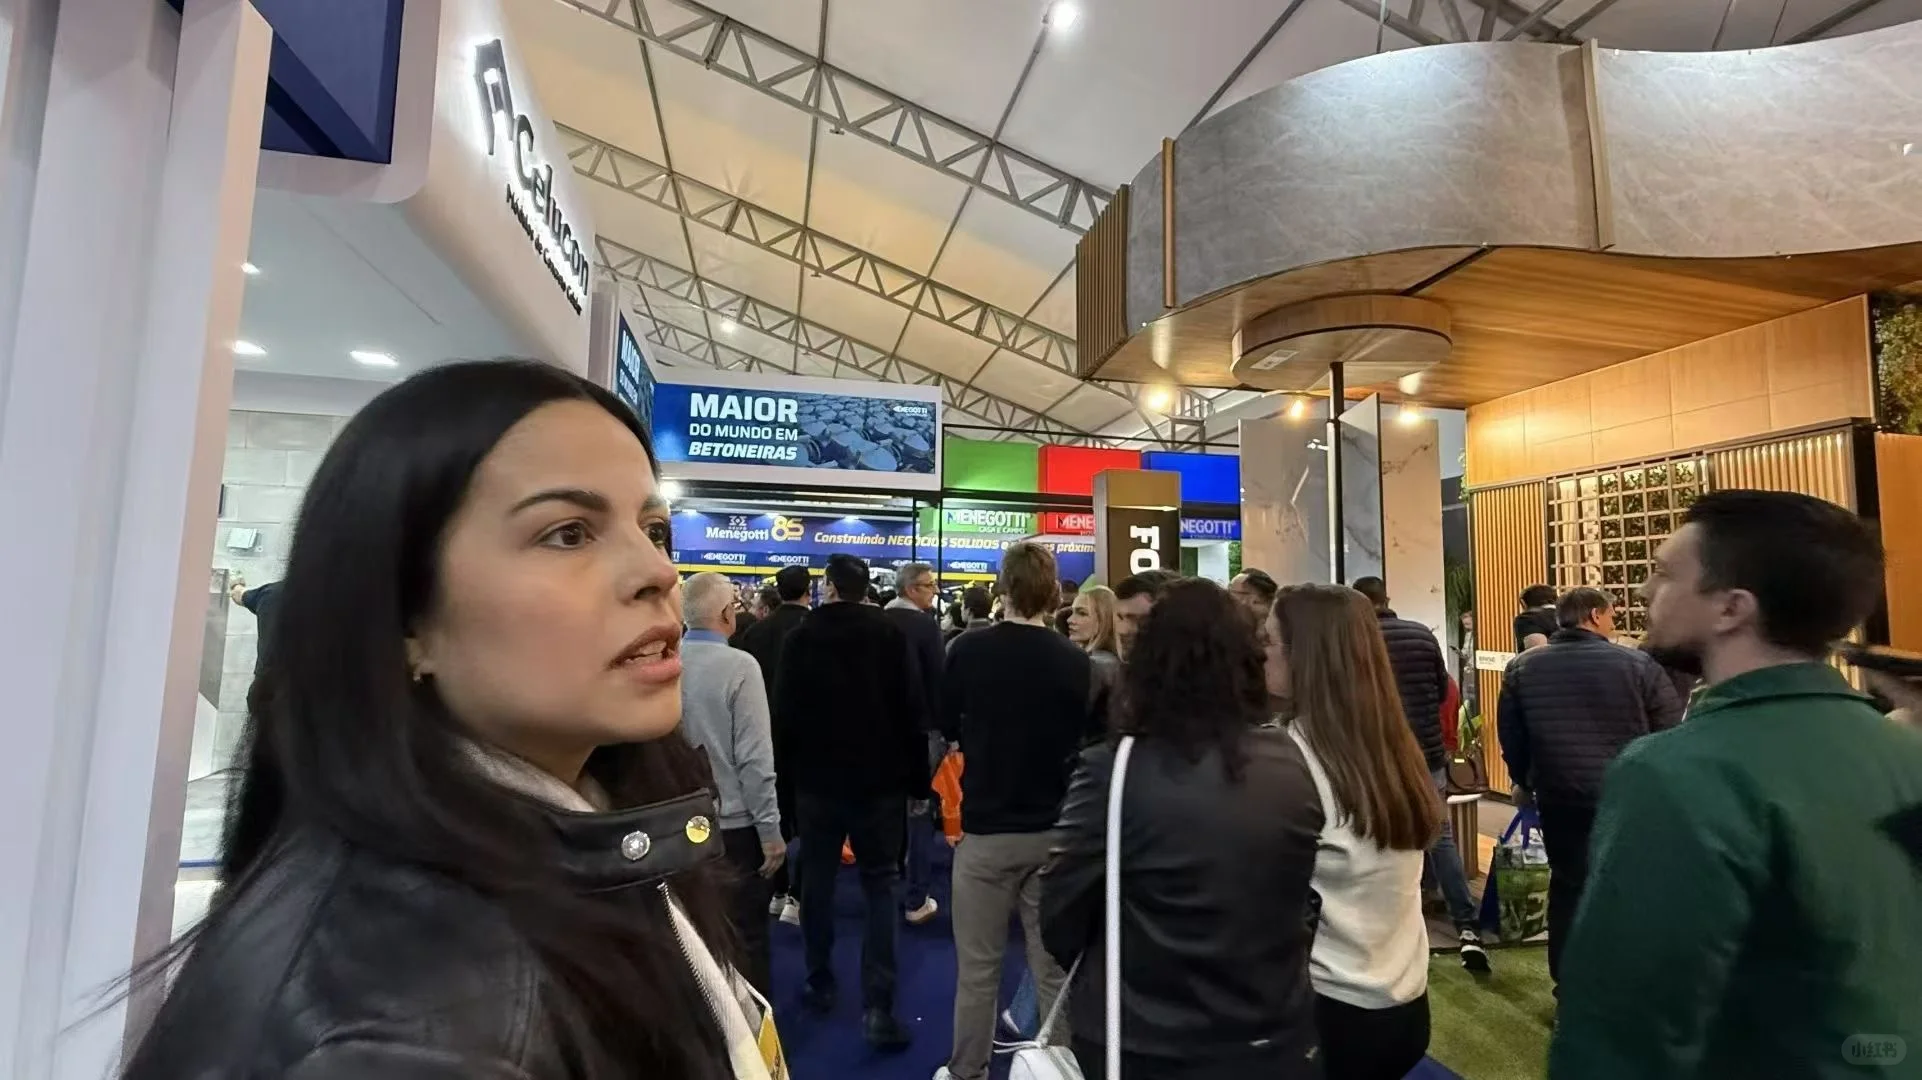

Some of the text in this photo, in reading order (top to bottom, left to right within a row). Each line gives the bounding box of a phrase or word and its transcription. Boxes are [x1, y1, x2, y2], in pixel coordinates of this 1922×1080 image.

[513, 114, 589, 296] Celucon
[690, 391, 798, 423] MAIOR
[689, 423, 798, 441] DO MUNDO EM
[688, 442, 798, 460] BETONEIRAS
[705, 527, 769, 542] Menegotti
[770, 515, 804, 541] 85
[814, 532, 885, 545] Construindo
